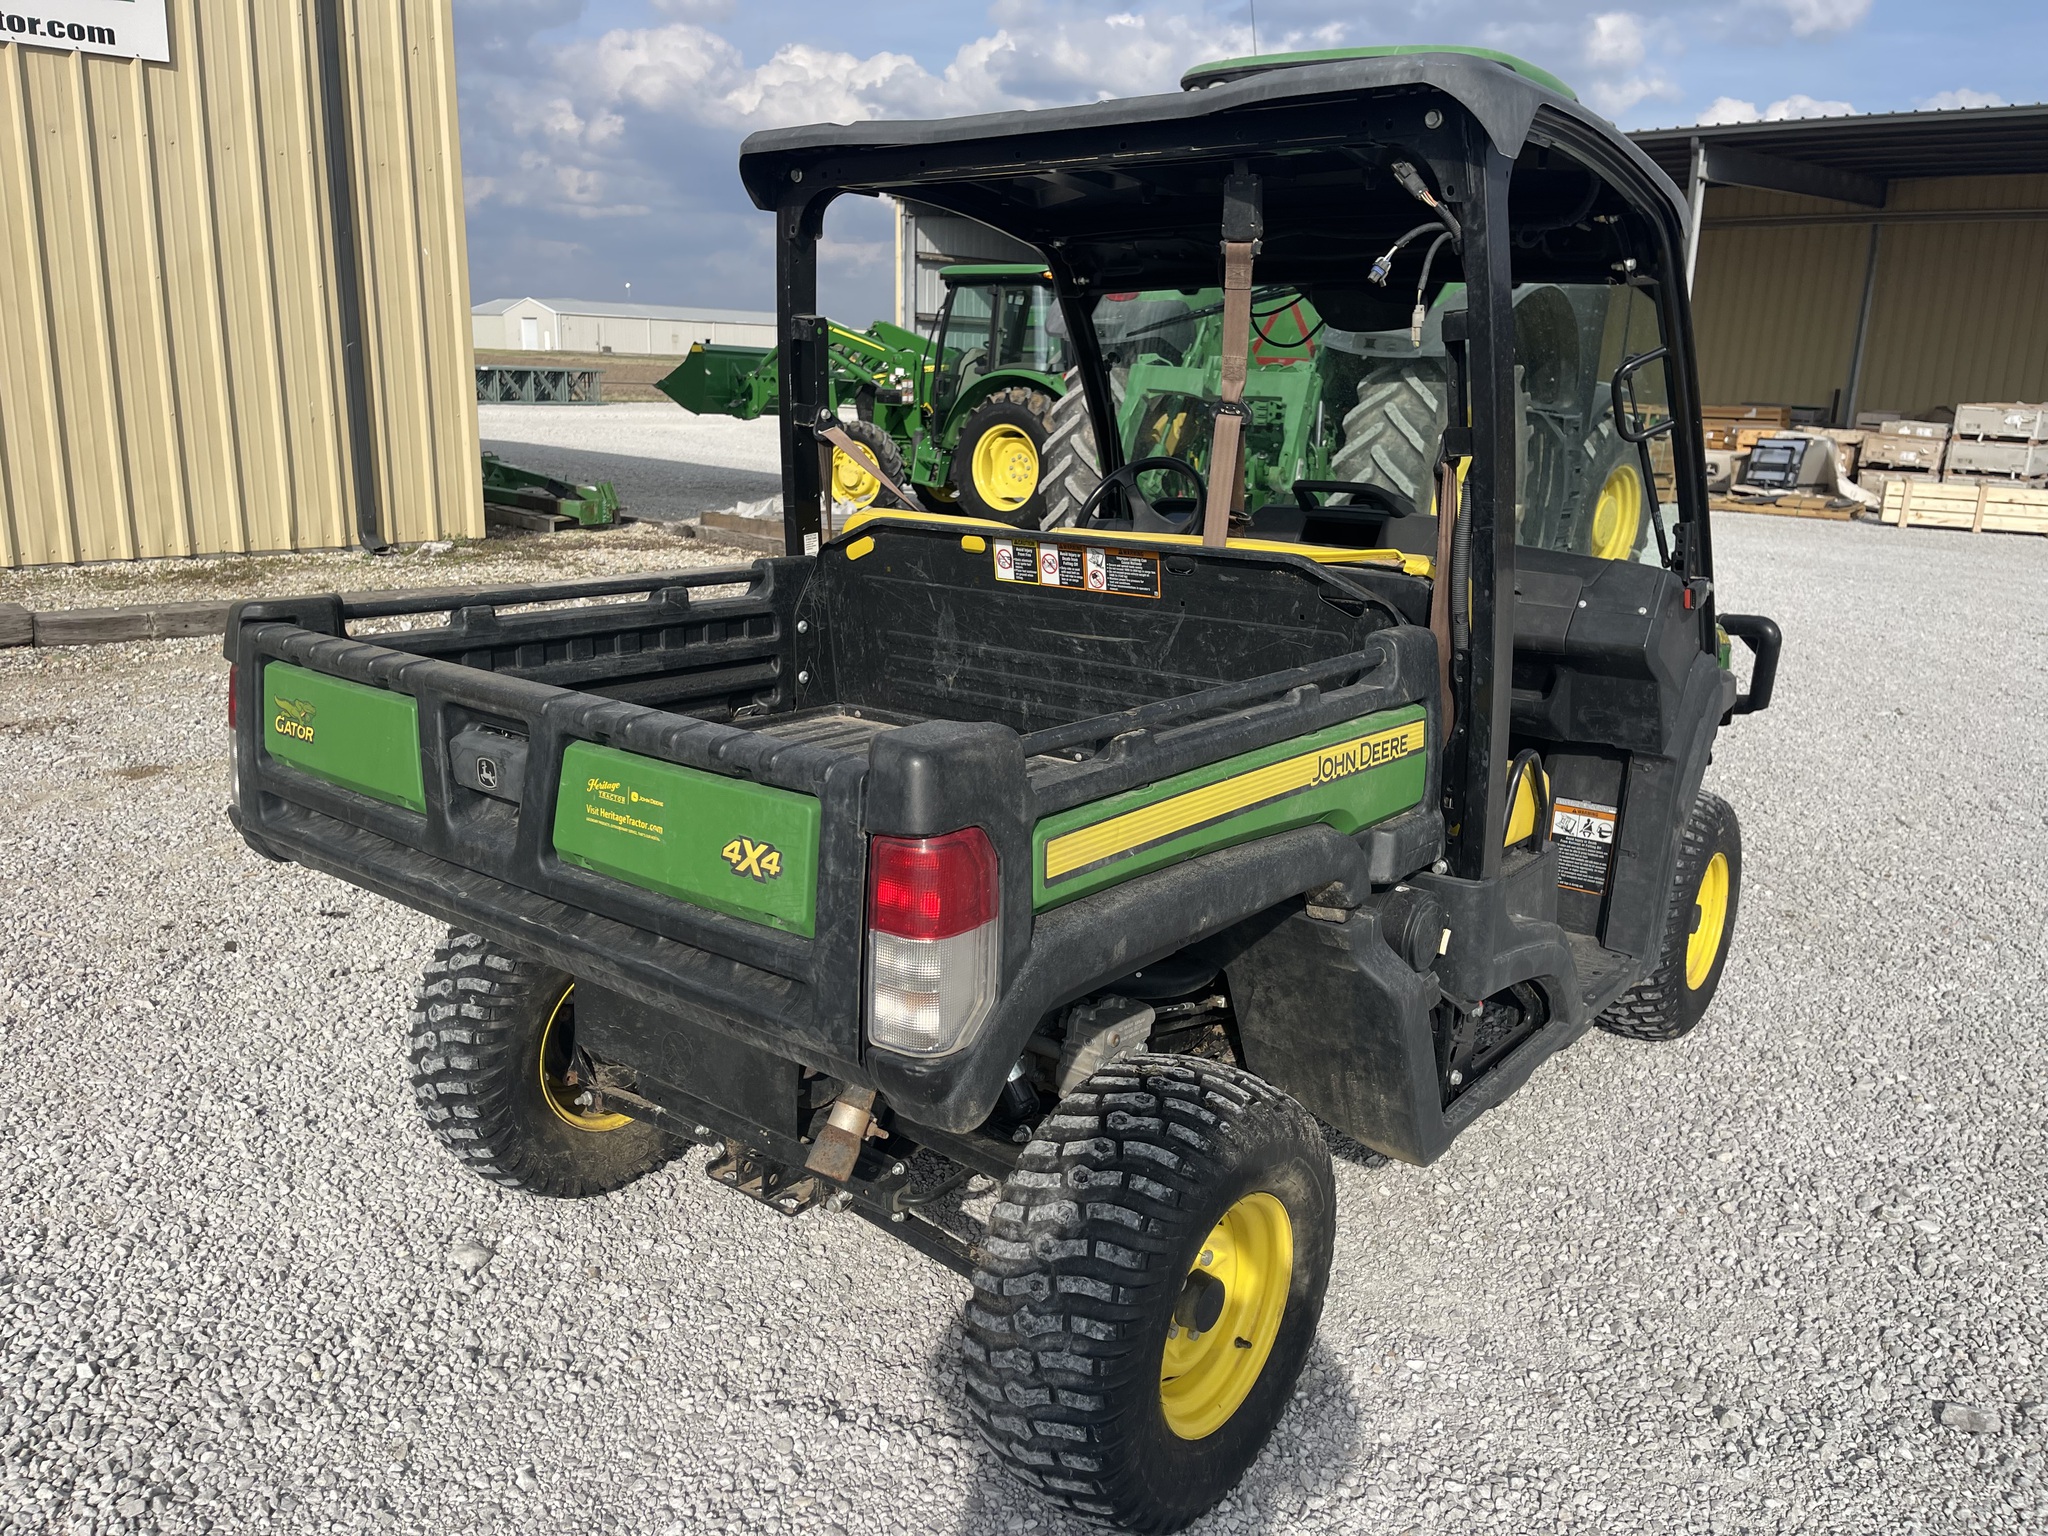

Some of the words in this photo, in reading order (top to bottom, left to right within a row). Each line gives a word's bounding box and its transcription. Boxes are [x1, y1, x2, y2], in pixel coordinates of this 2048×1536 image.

[275, 714, 314, 743] GATOR
[1312, 749, 1357, 784] JOHN
[1359, 733, 1409, 767] DEERE
[586, 778, 621, 792] Heritage
[598, 790, 626, 805] TRACTOR
[586, 804, 600, 816] Visit
[600, 807, 663, 835] HeritageTractor.com
[1577, 808, 1599, 817] WARNING
